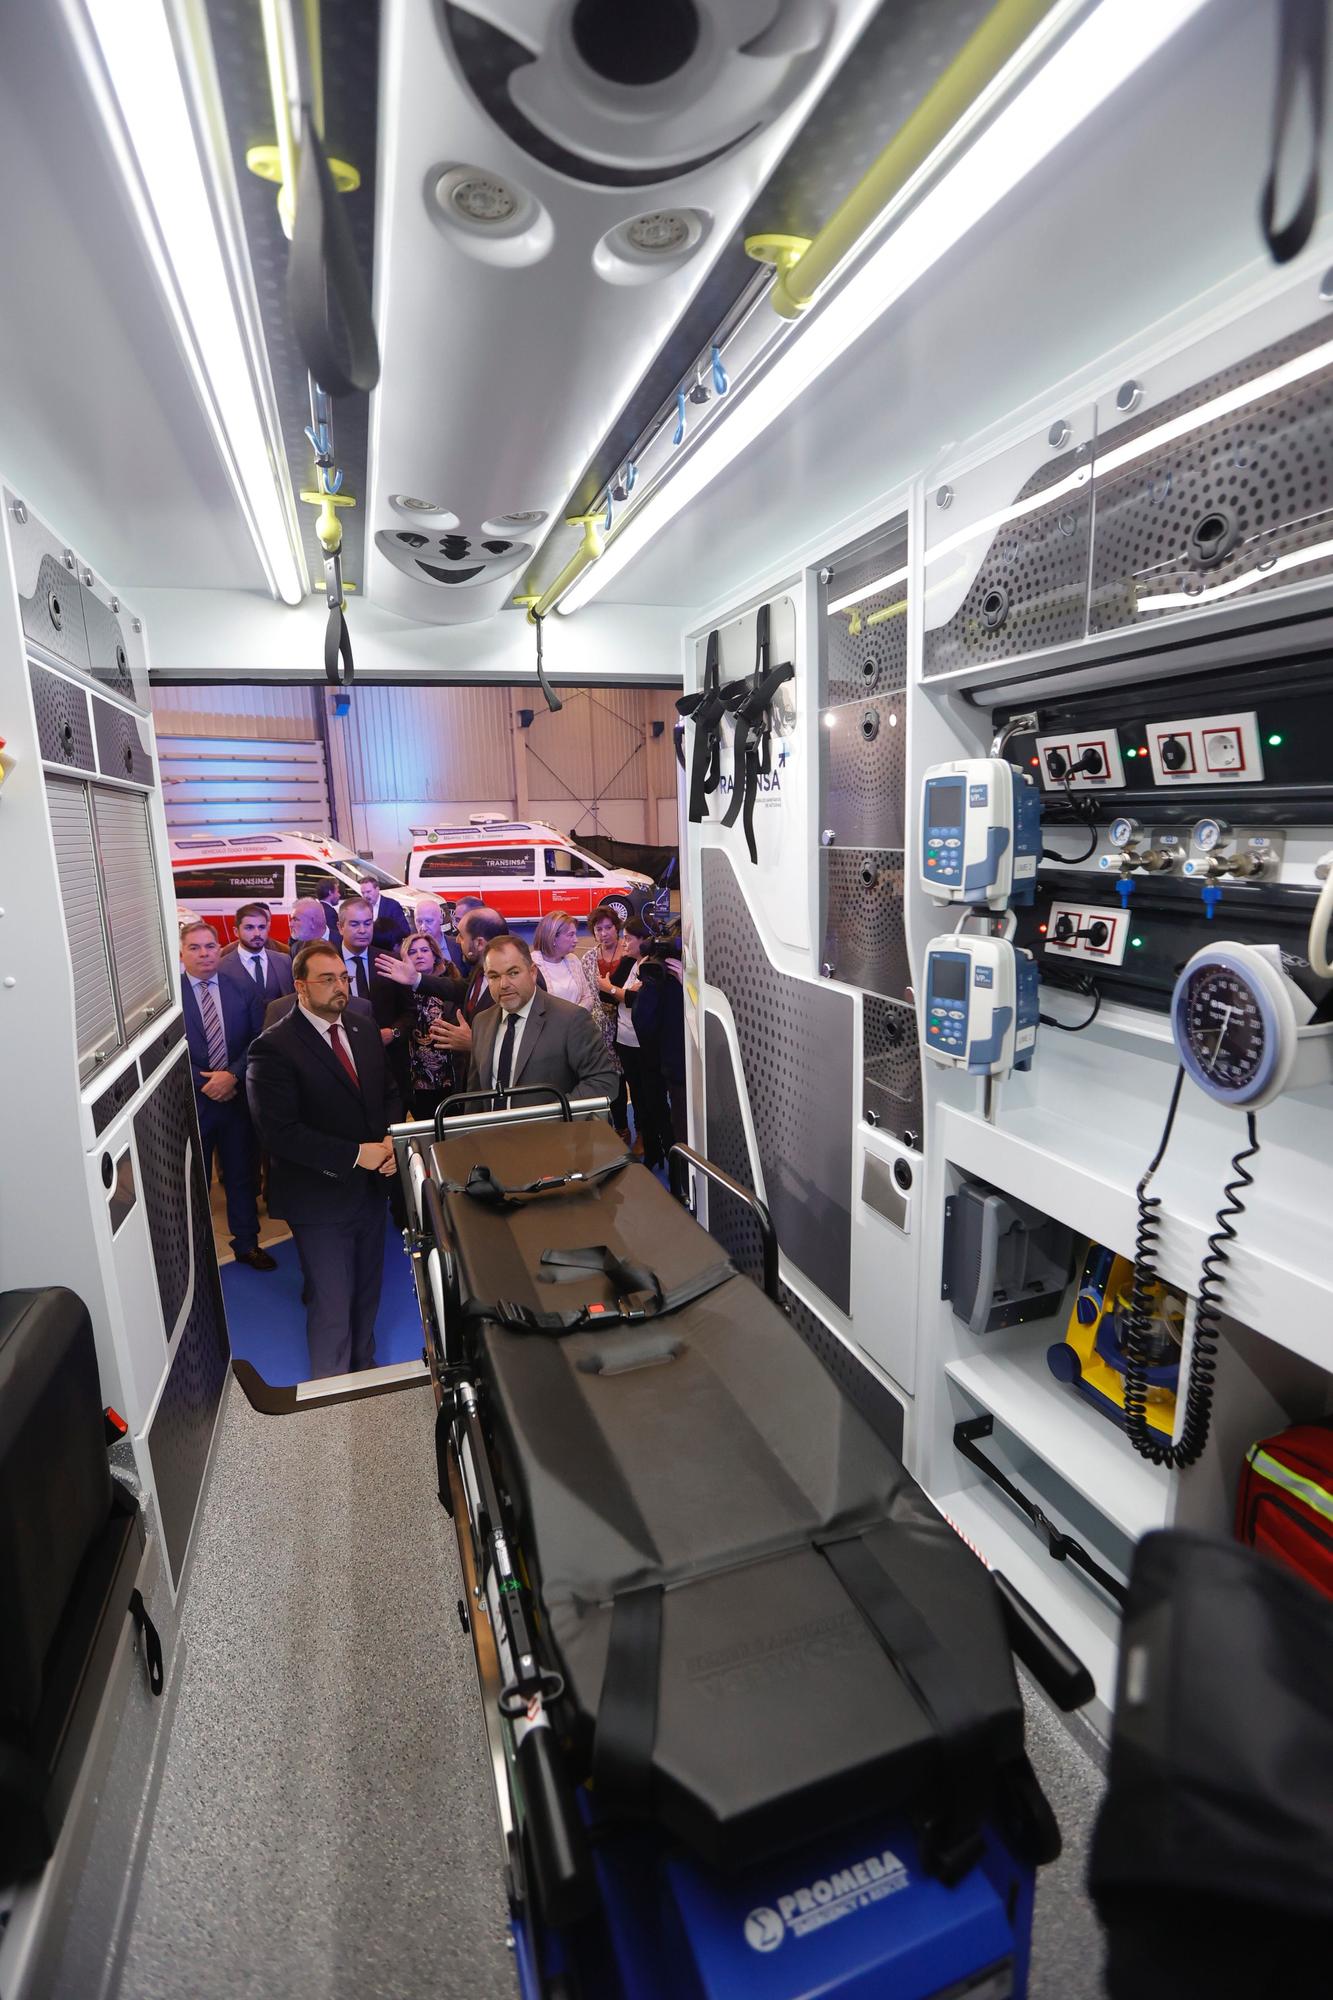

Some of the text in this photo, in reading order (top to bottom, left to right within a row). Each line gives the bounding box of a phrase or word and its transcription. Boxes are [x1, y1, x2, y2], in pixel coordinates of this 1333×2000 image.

[486, 859, 526, 867] TRANSINSA
[230, 877, 274, 886] TRANSINSA
[1218, 980, 1227, 989] 140
[1229, 983, 1239, 992] 160
[1246, 1004, 1256, 1014] 200
[1250, 1019, 1261, 1029] 220
[1250, 1035, 1261, 1045] 240
[777, 1850, 905, 1921] PROMEBA
